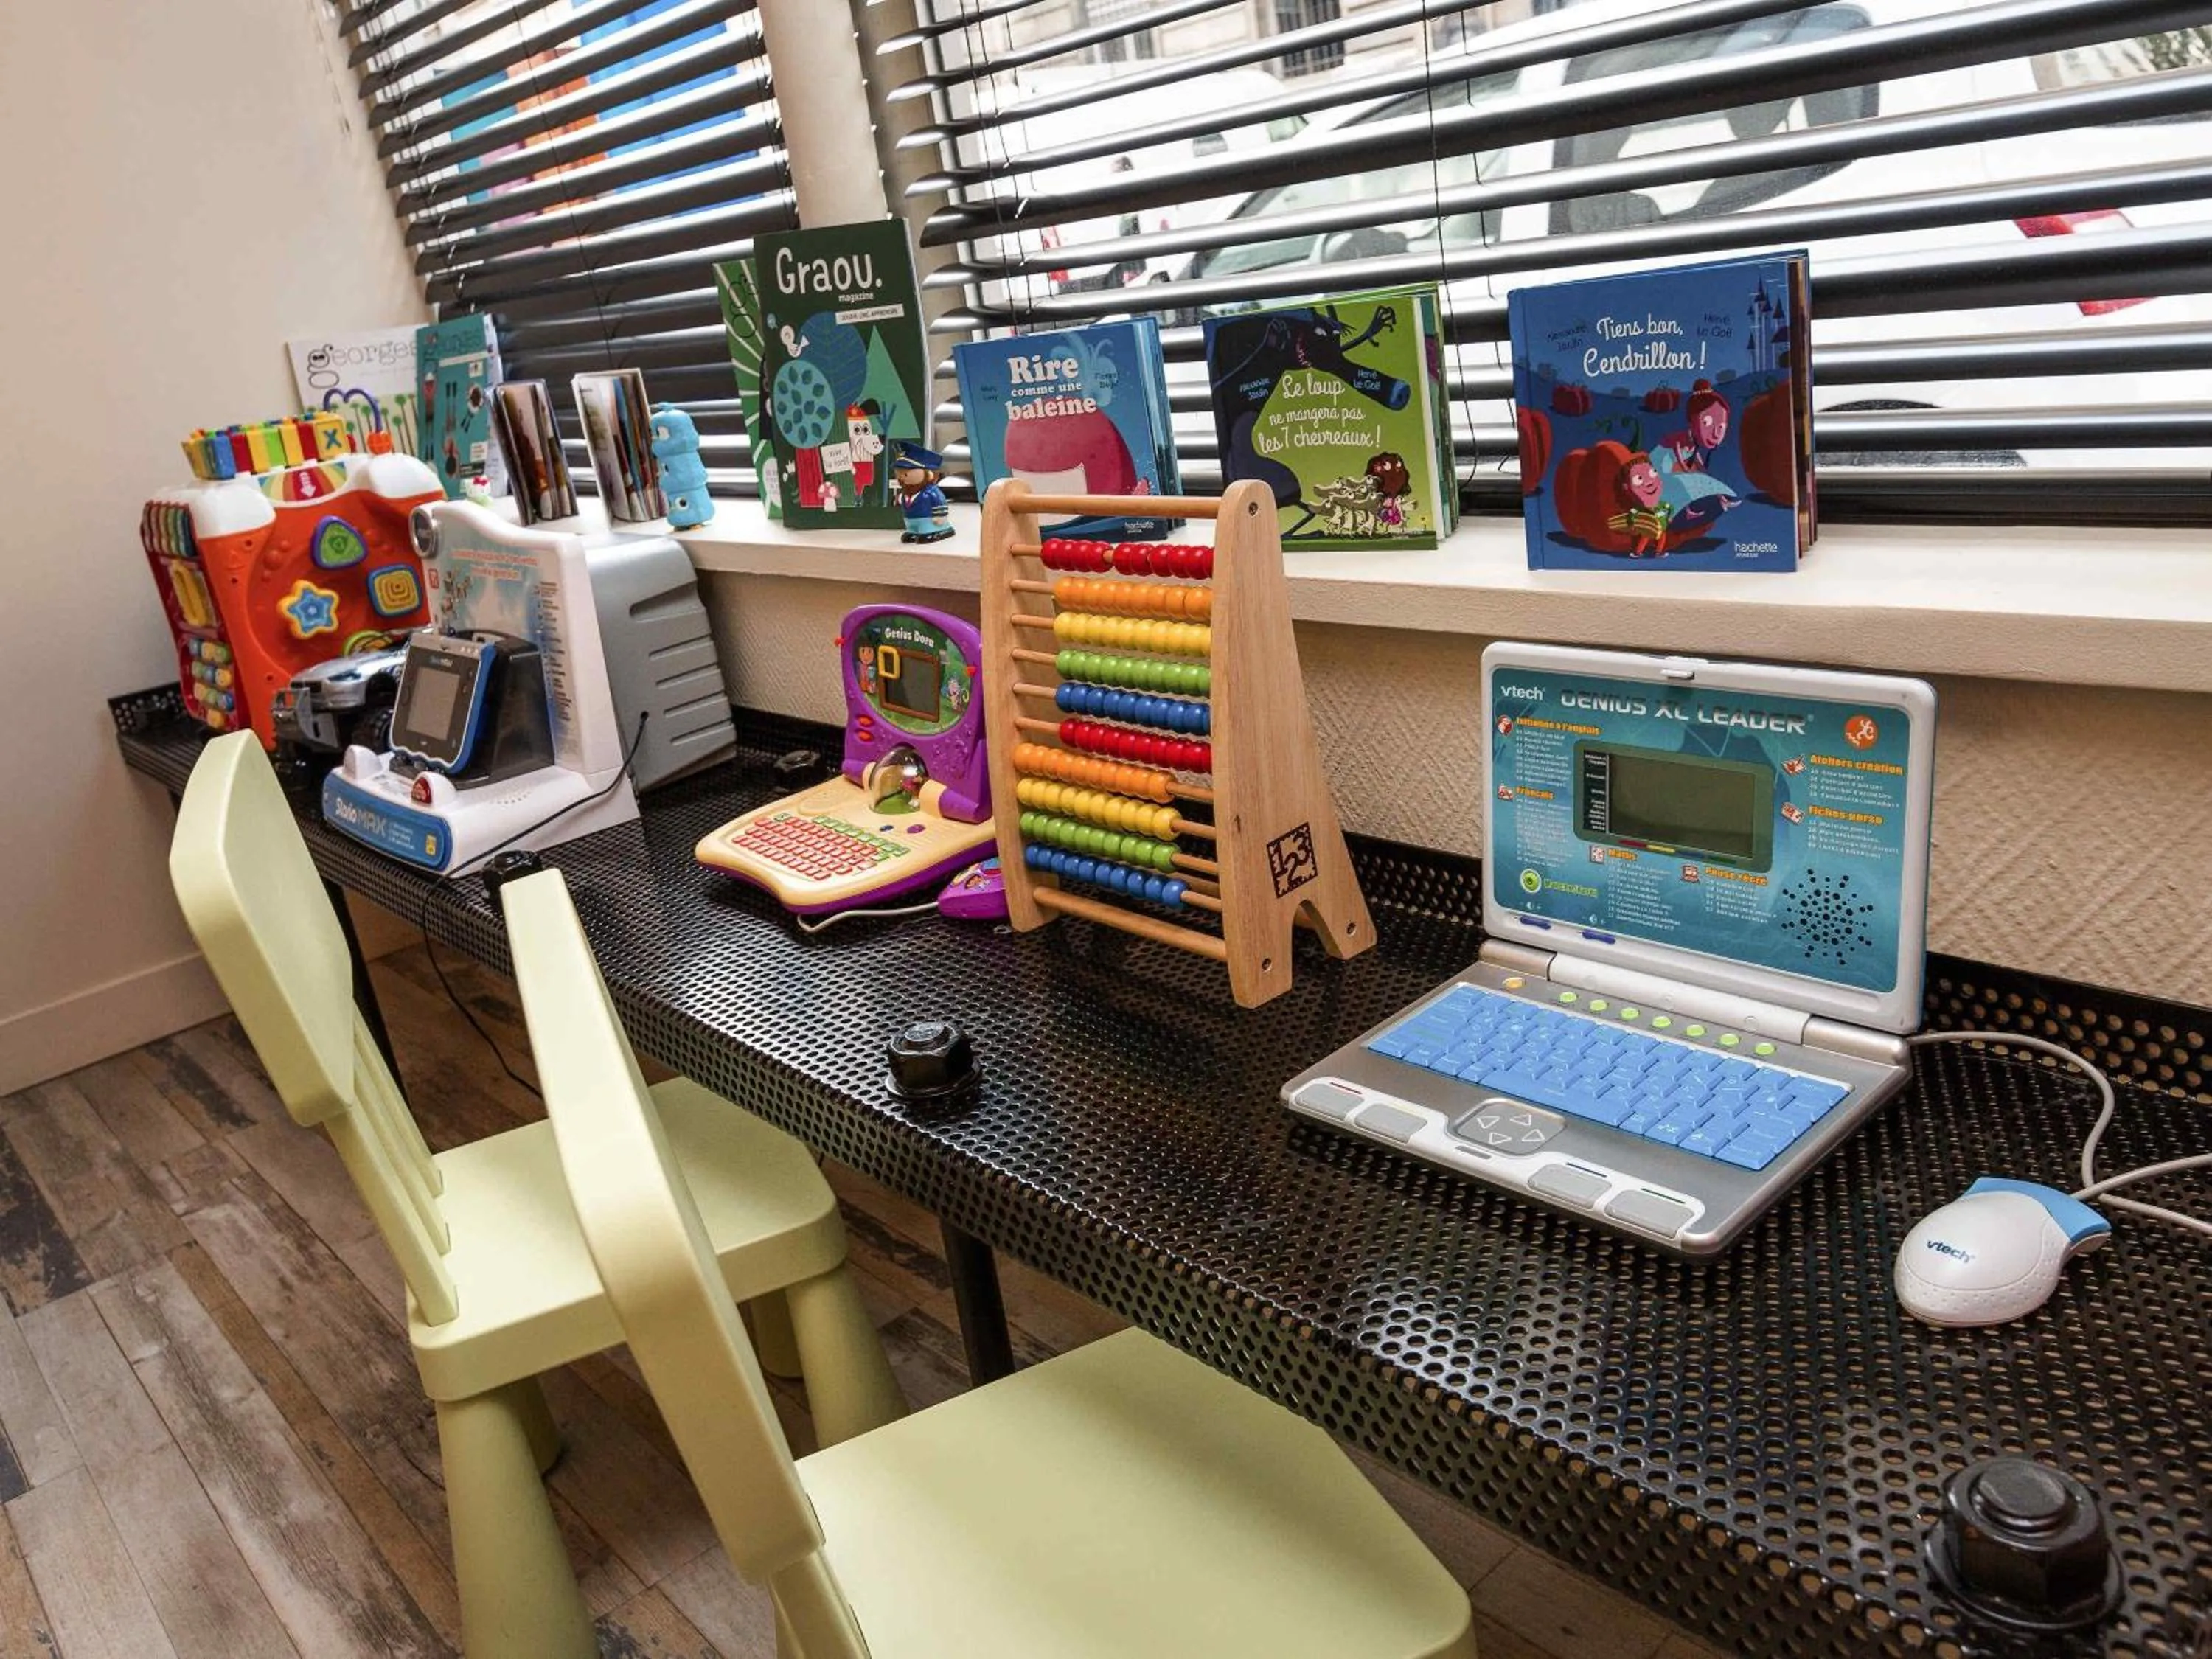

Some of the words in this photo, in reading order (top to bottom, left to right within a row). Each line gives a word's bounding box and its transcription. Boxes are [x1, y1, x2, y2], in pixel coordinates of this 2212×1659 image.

[776, 246, 883, 295] Graou.
[838, 291, 874, 303] magazine
[1596, 316, 1643, 342] Tiens
[1646, 313, 1683, 337] bon,
[1007, 354, 1079, 384] Rire
[1583, 341, 1696, 378] Cendrillon
[1011, 385, 1054, 397] comme
[1059, 381, 1082, 392] une
[1282, 375, 1305, 399] Le
[1307, 372, 1345, 406] loup
[1005, 395, 1097, 420] baleine
[1270, 414, 1285, 425] ne
[1287, 408, 1340, 428] mangera
[1341, 408, 1366, 428] pas
[323, 429, 342, 450] X
[1258, 432, 1284, 454] les
[1294, 424, 1374, 447] chevreaux
[1733, 541, 1778, 552] hachette
[885, 627, 912, 641] Genius
[914, 630, 934, 648] Dora
[1500, 685, 1543, 701] vtech
[1560, 689, 1647, 715] GENIUS
[1654, 700, 1689, 720] XL
[1697, 704, 1806, 735] LEADER
[1926, 1238, 1971, 1264] vtech
